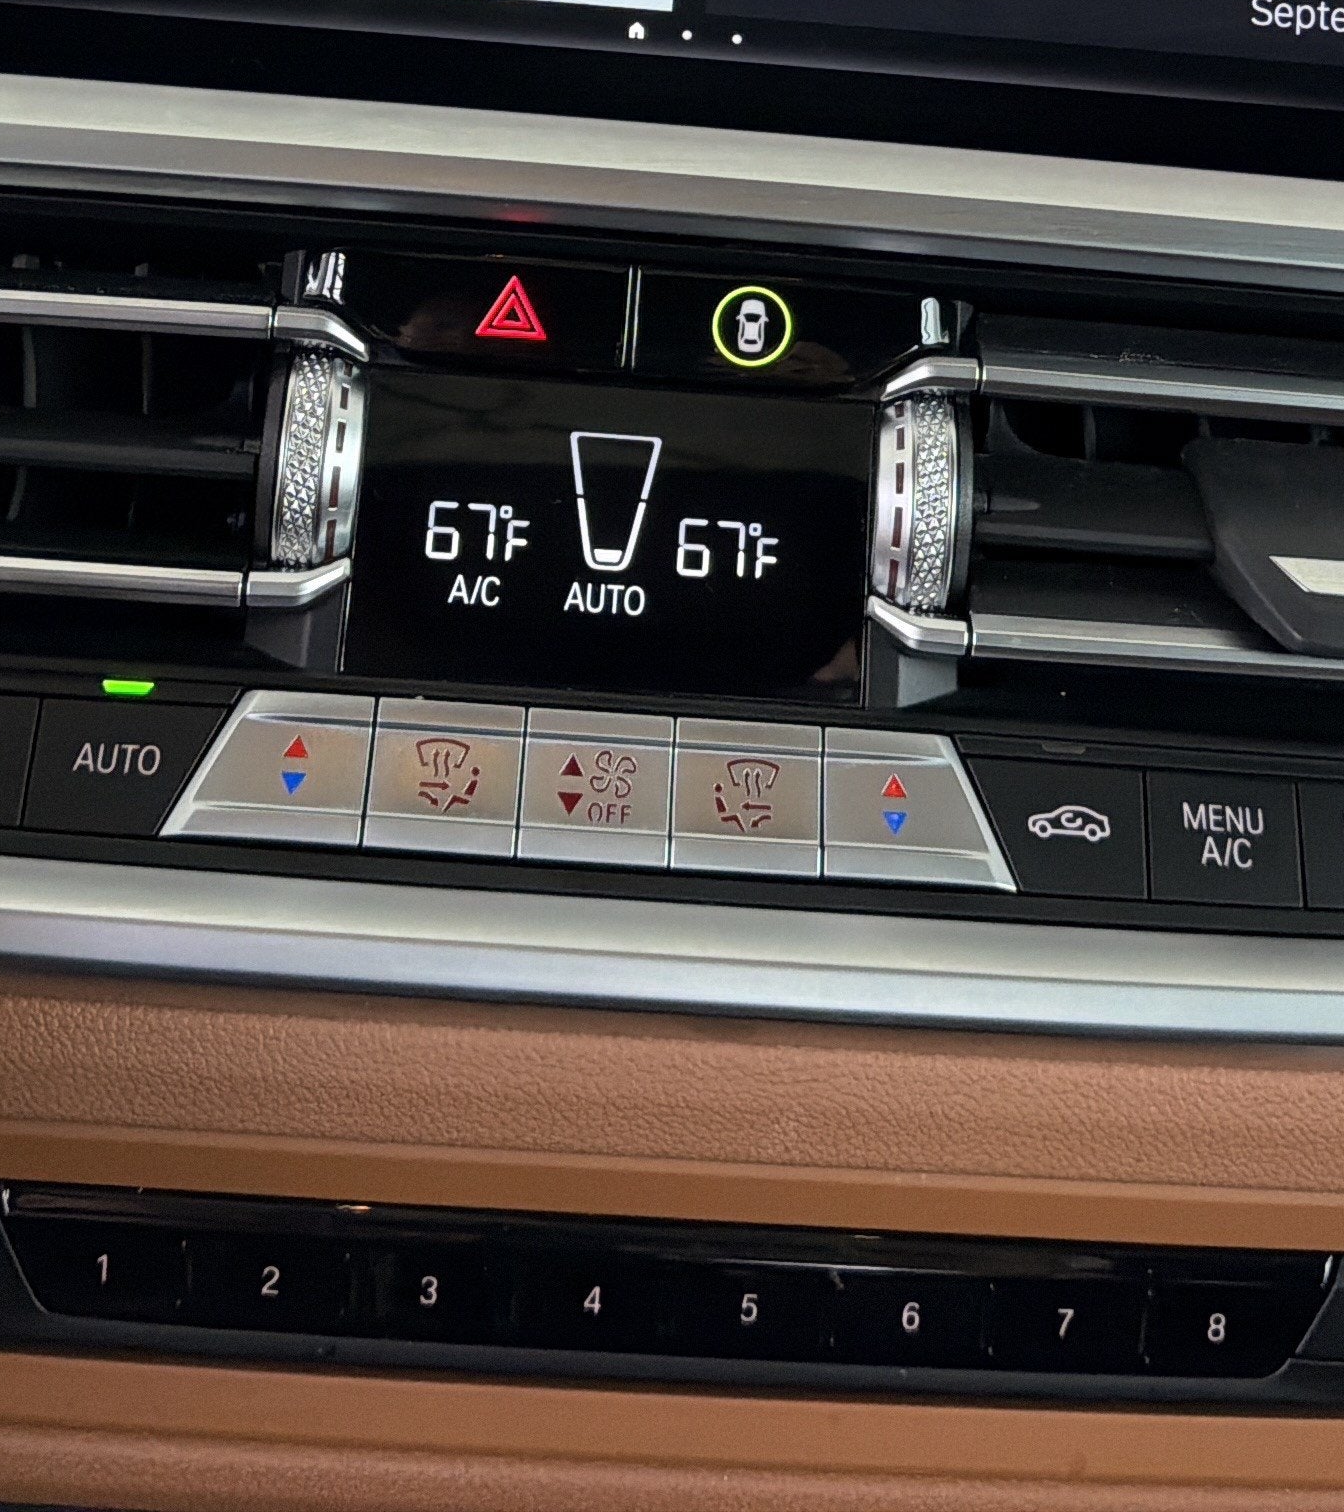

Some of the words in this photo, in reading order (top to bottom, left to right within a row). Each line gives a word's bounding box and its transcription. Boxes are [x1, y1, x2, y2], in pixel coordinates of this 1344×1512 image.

[447, 574, 501, 606] A/C
[563, 582, 646, 616] AUTO
[72, 742, 162, 777] AUTO
[586, 801, 633, 825] OFF
[1182, 801, 1264, 835] MENU
[1201, 838, 1253, 870] A/C
[97, 1254, 110, 1285] 1
[261, 1266, 280, 1297] 2
[419, 1275, 438, 1306] 3
[584, 1285, 602, 1316] 4
[741, 1293, 758, 1324] 5
[902, 1300, 920, 1331] 6
[1057, 1309, 1074, 1339] 7
[1207, 1313, 1225, 1344] 8
